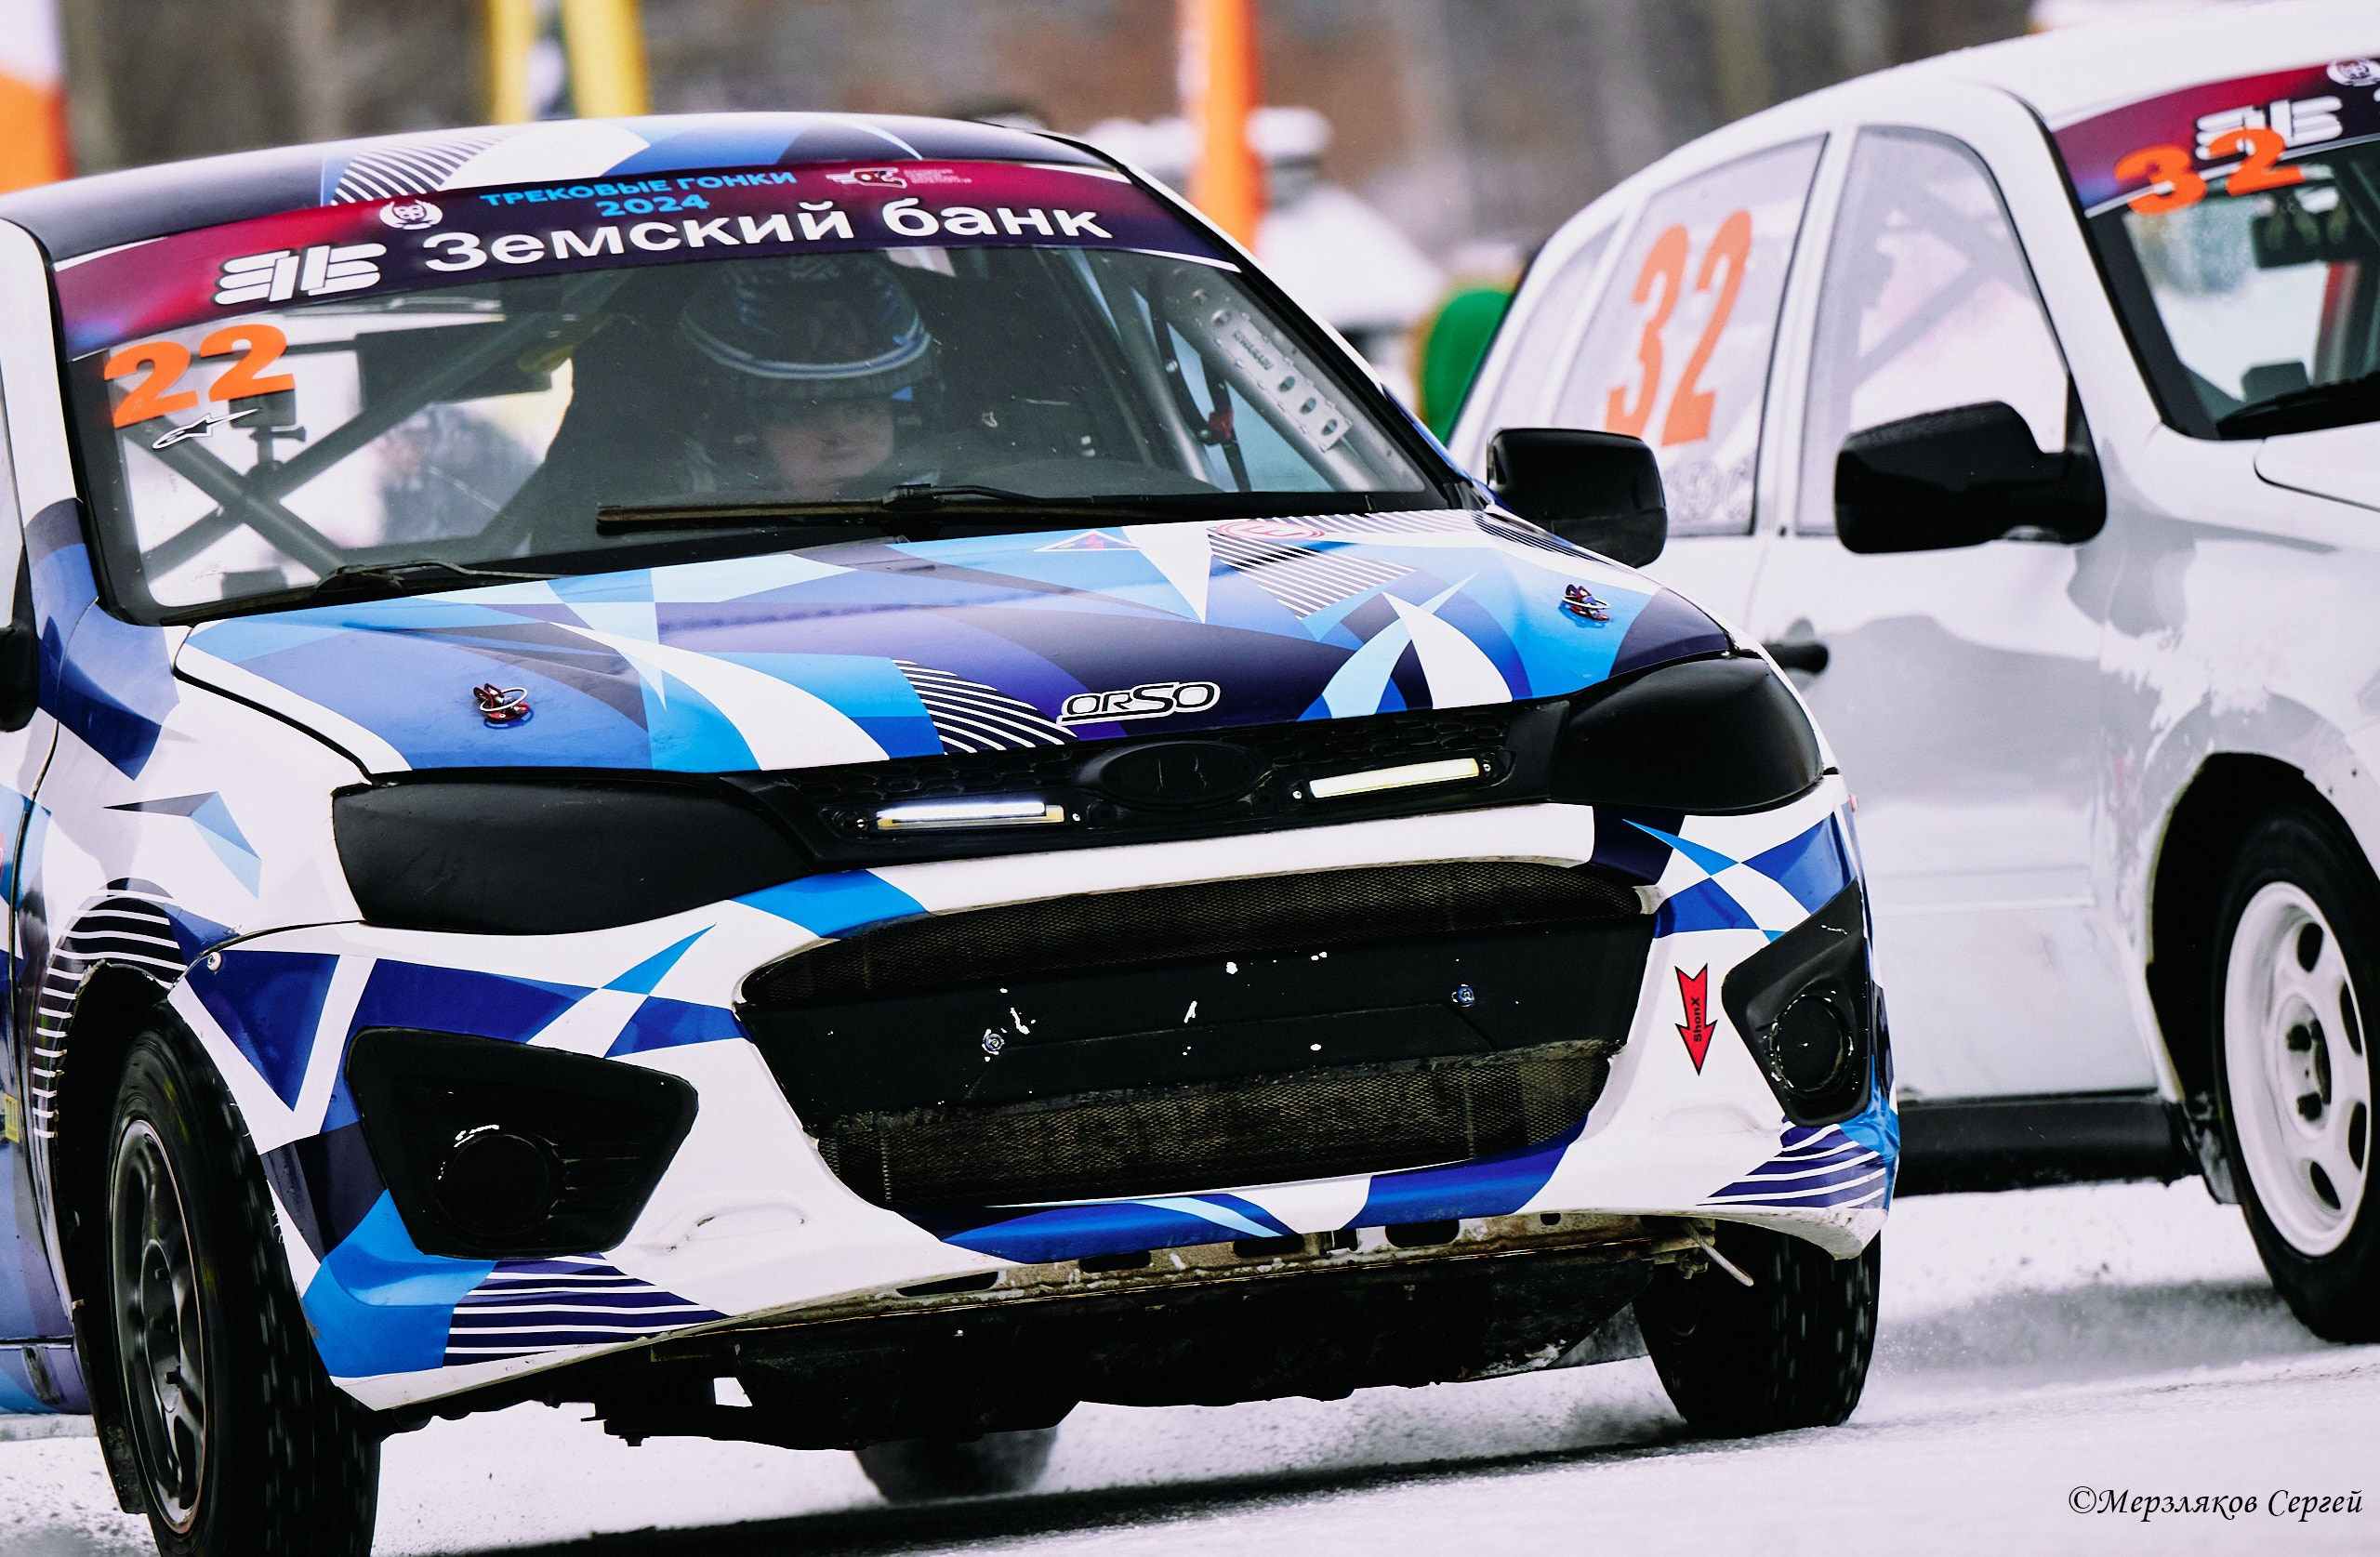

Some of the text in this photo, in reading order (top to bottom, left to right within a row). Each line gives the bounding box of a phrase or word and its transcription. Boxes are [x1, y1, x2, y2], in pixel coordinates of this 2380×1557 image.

[479, 171, 798, 206] ТРЕКОВЫЕ ГОНКИ
[596, 193, 710, 217] 2024
[2113, 125, 2305, 215] 32
[422, 197, 1114, 272] Земский банк
[1605, 207, 1752, 447] 32
[103, 323, 297, 429] 22
[1691, 996, 1702, 1042] ShonX
